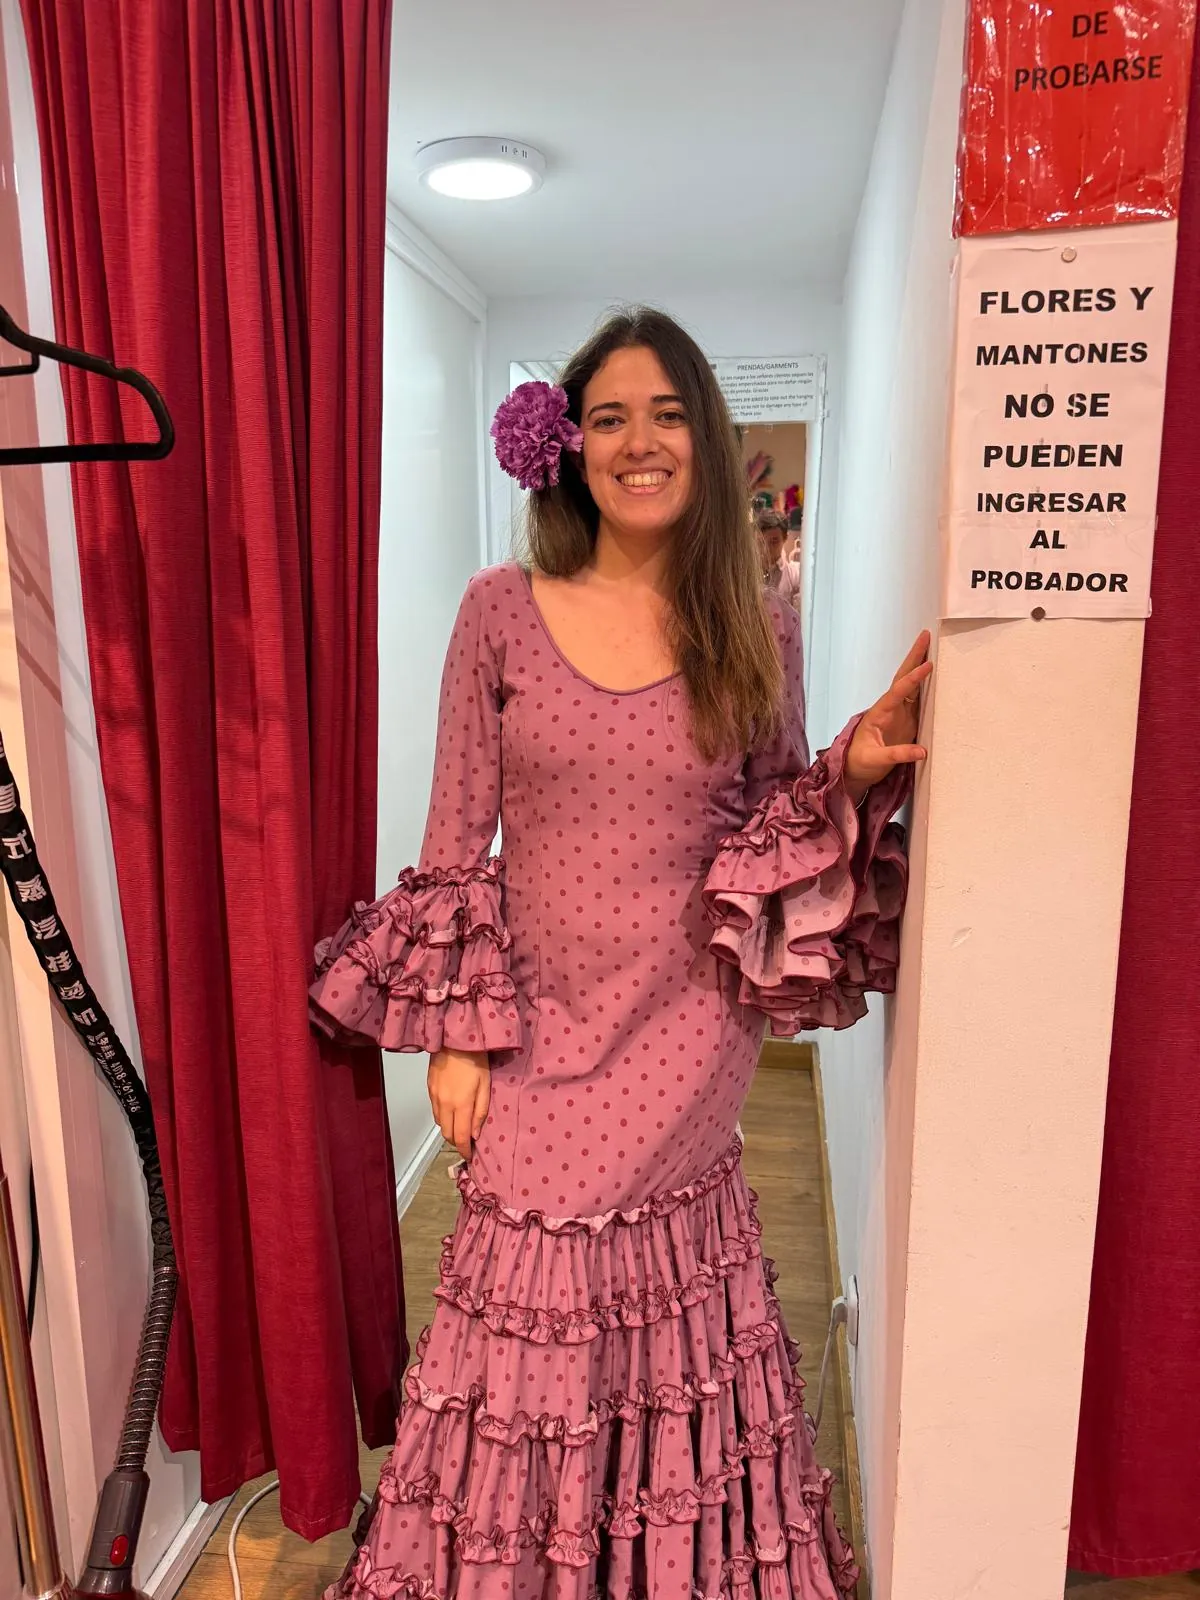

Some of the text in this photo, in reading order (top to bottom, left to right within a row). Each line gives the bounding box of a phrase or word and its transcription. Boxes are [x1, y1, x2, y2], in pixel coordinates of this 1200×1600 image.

[1072, 11, 1109, 38] DE
[1014, 55, 1163, 92] PROBARSE
[980, 287, 1154, 314] FLORES Y
[975, 342, 1148, 366] MANTONES
[737, 362, 799, 371] PRENDAS/GARMENTS
[1004, 393, 1111, 418] NO SE
[983, 444, 1123, 468] PUEDEN
[977, 492, 1127, 513] INGRESAR
[1029, 530, 1066, 549] AL
[971, 570, 1128, 592] PROBADOR
